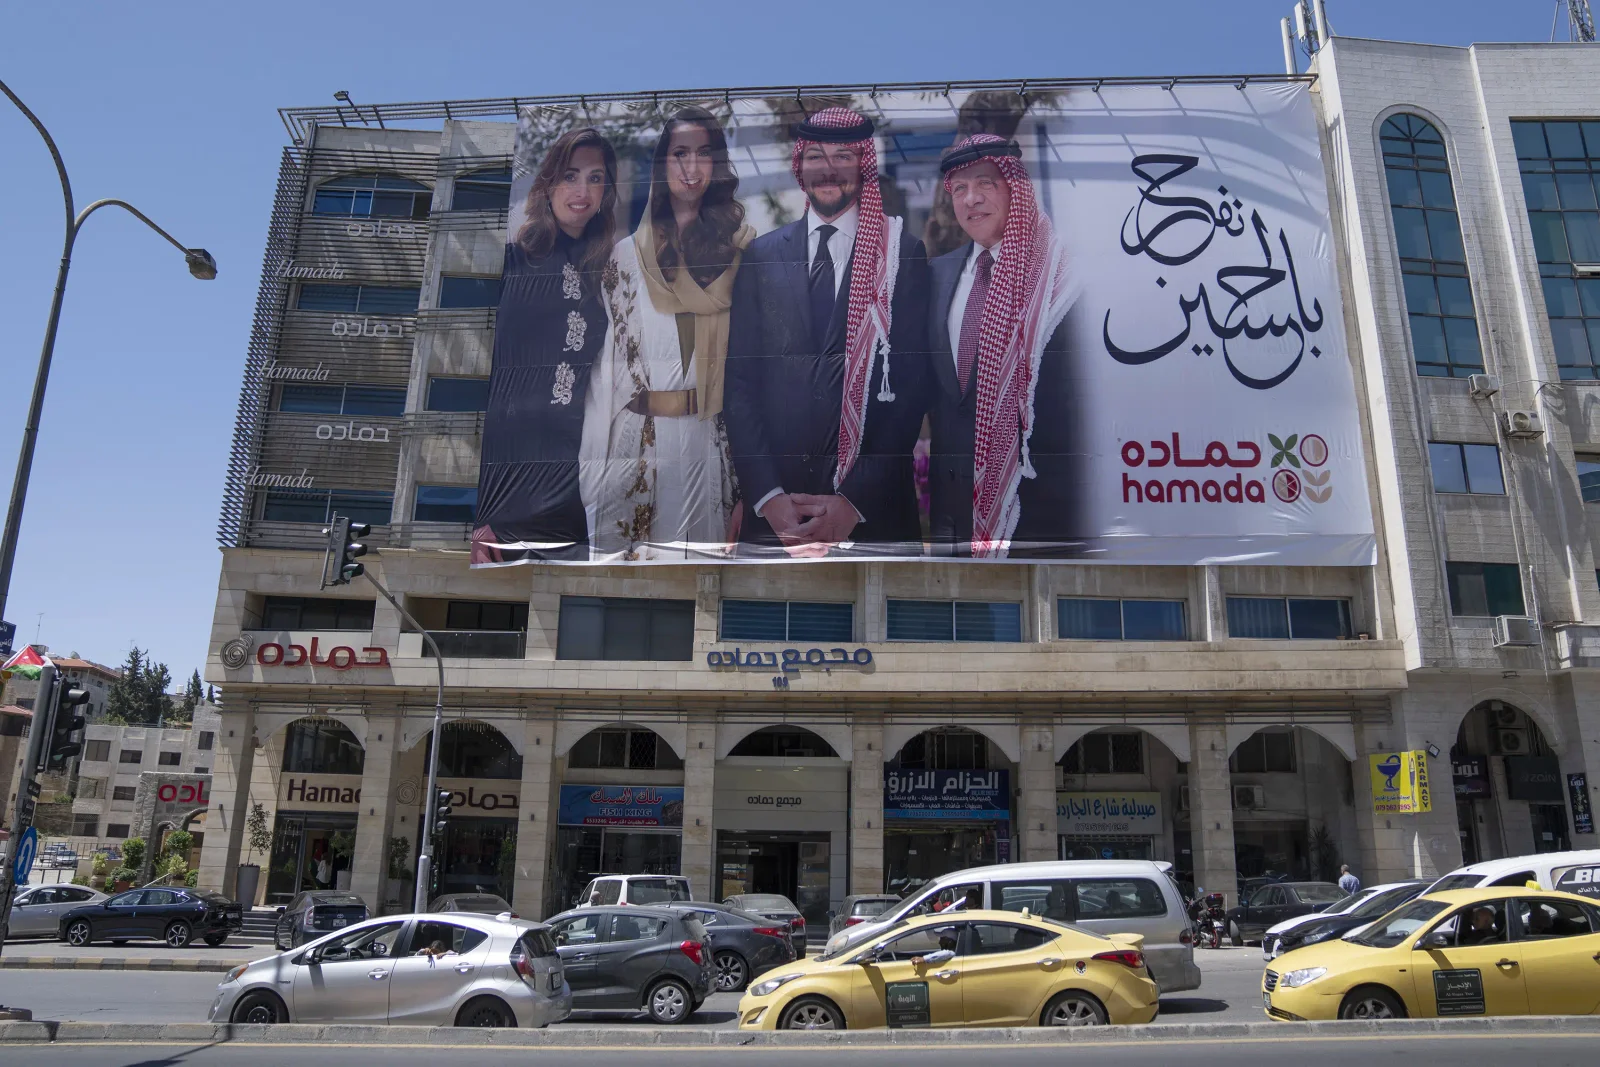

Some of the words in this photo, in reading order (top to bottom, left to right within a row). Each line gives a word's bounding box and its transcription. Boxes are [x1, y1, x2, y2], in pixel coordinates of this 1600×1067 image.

[276, 258, 345, 280] Hamada
[331, 318, 404, 339] حماده
[260, 359, 330, 382] Hamada
[315, 420, 390, 443] حماده
[1121, 432, 1262, 468] حماده
[242, 465, 315, 490] Hamada
[1122, 473, 1266, 504] hamada
[256, 636, 390, 670] حماده
[707, 647, 778, 666] حماده
[781, 648, 873, 672] مجمع
[158, 781, 209, 804] اده
[287, 779, 360, 804] Hama
[942, 771, 999, 794] الحزام
[1416, 754, 1429, 808] PHARMACY
[451, 786, 519, 810] حماد
[590, 786, 632, 805] السمك
[635, 787, 663, 805] ملك
[747, 795, 774, 804] حماده
[776, 796, 802, 807] مجمع
[598, 807, 623, 816] FISH
[625, 808, 653, 817] KING
[1057, 798, 1091, 819] الجاردن
[1094, 798, 1120, 819] شارع
[1122, 798, 1156, 820] صيدلية
